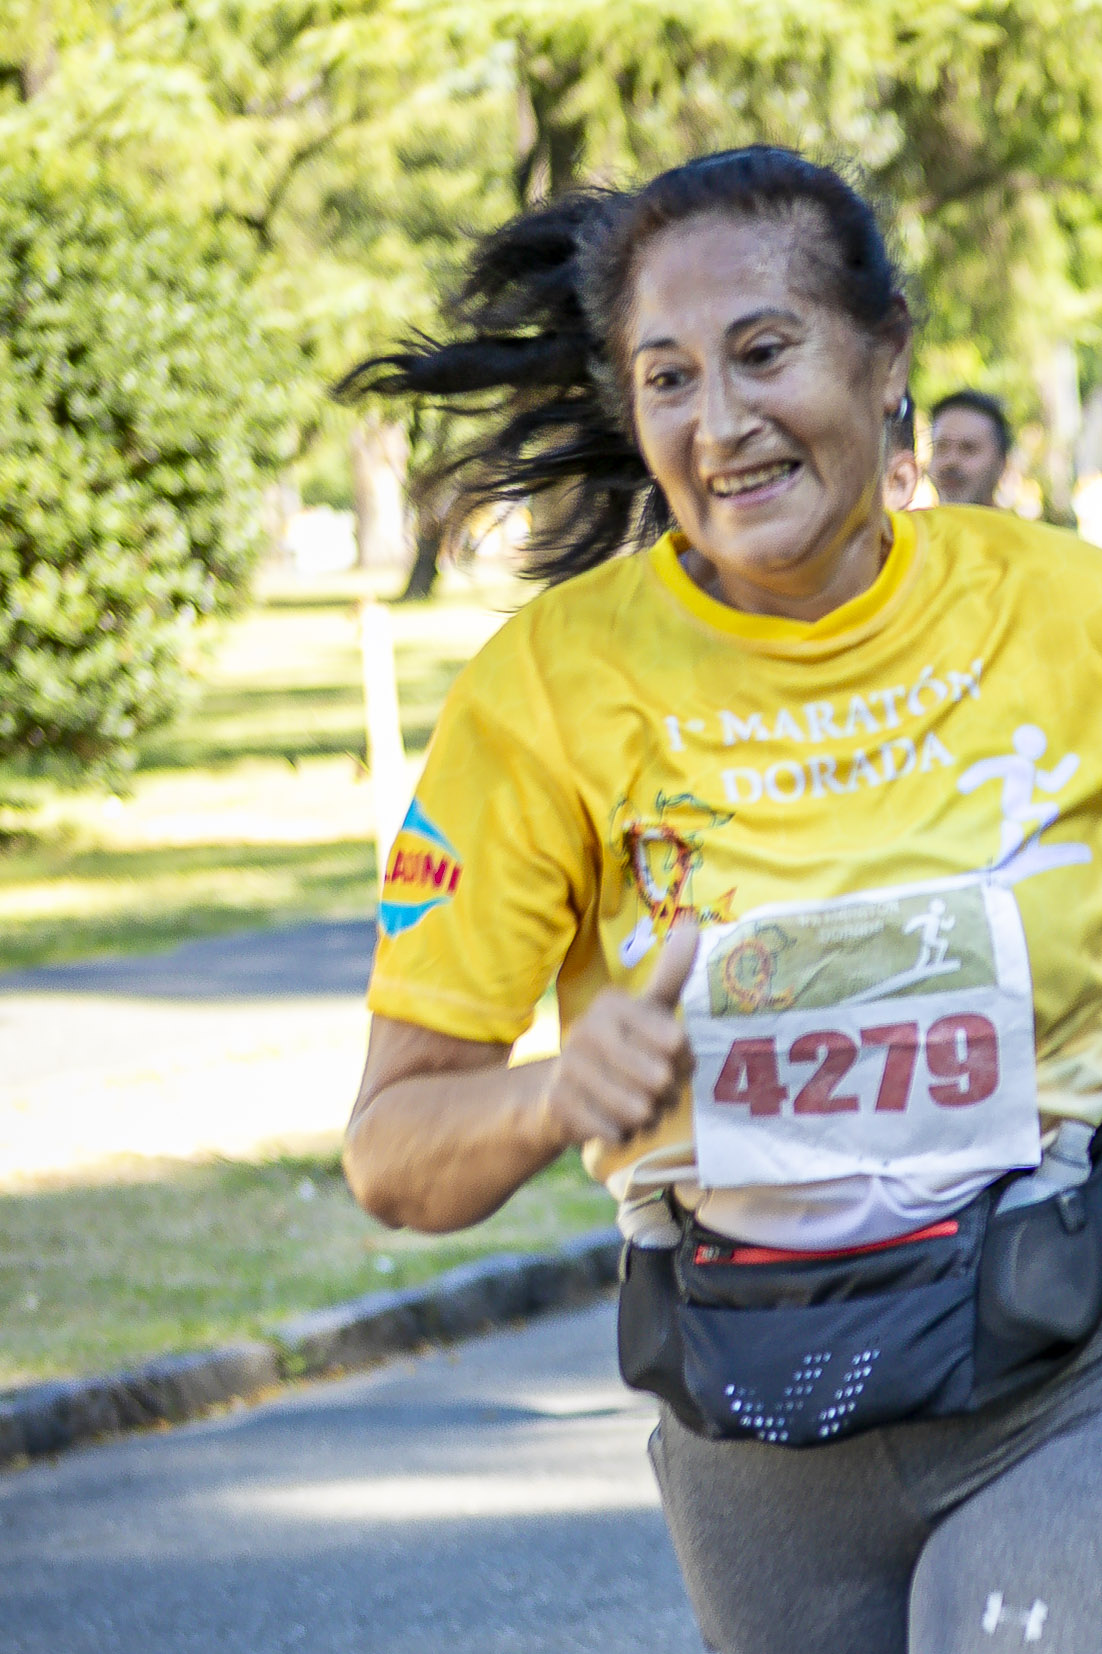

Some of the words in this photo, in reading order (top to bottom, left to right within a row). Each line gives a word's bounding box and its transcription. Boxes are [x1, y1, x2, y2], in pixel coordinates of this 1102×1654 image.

[718, 657, 985, 747] MARATÓN
[720, 731, 956, 805] DORADA
[713, 1011, 1000, 1117] 4279
